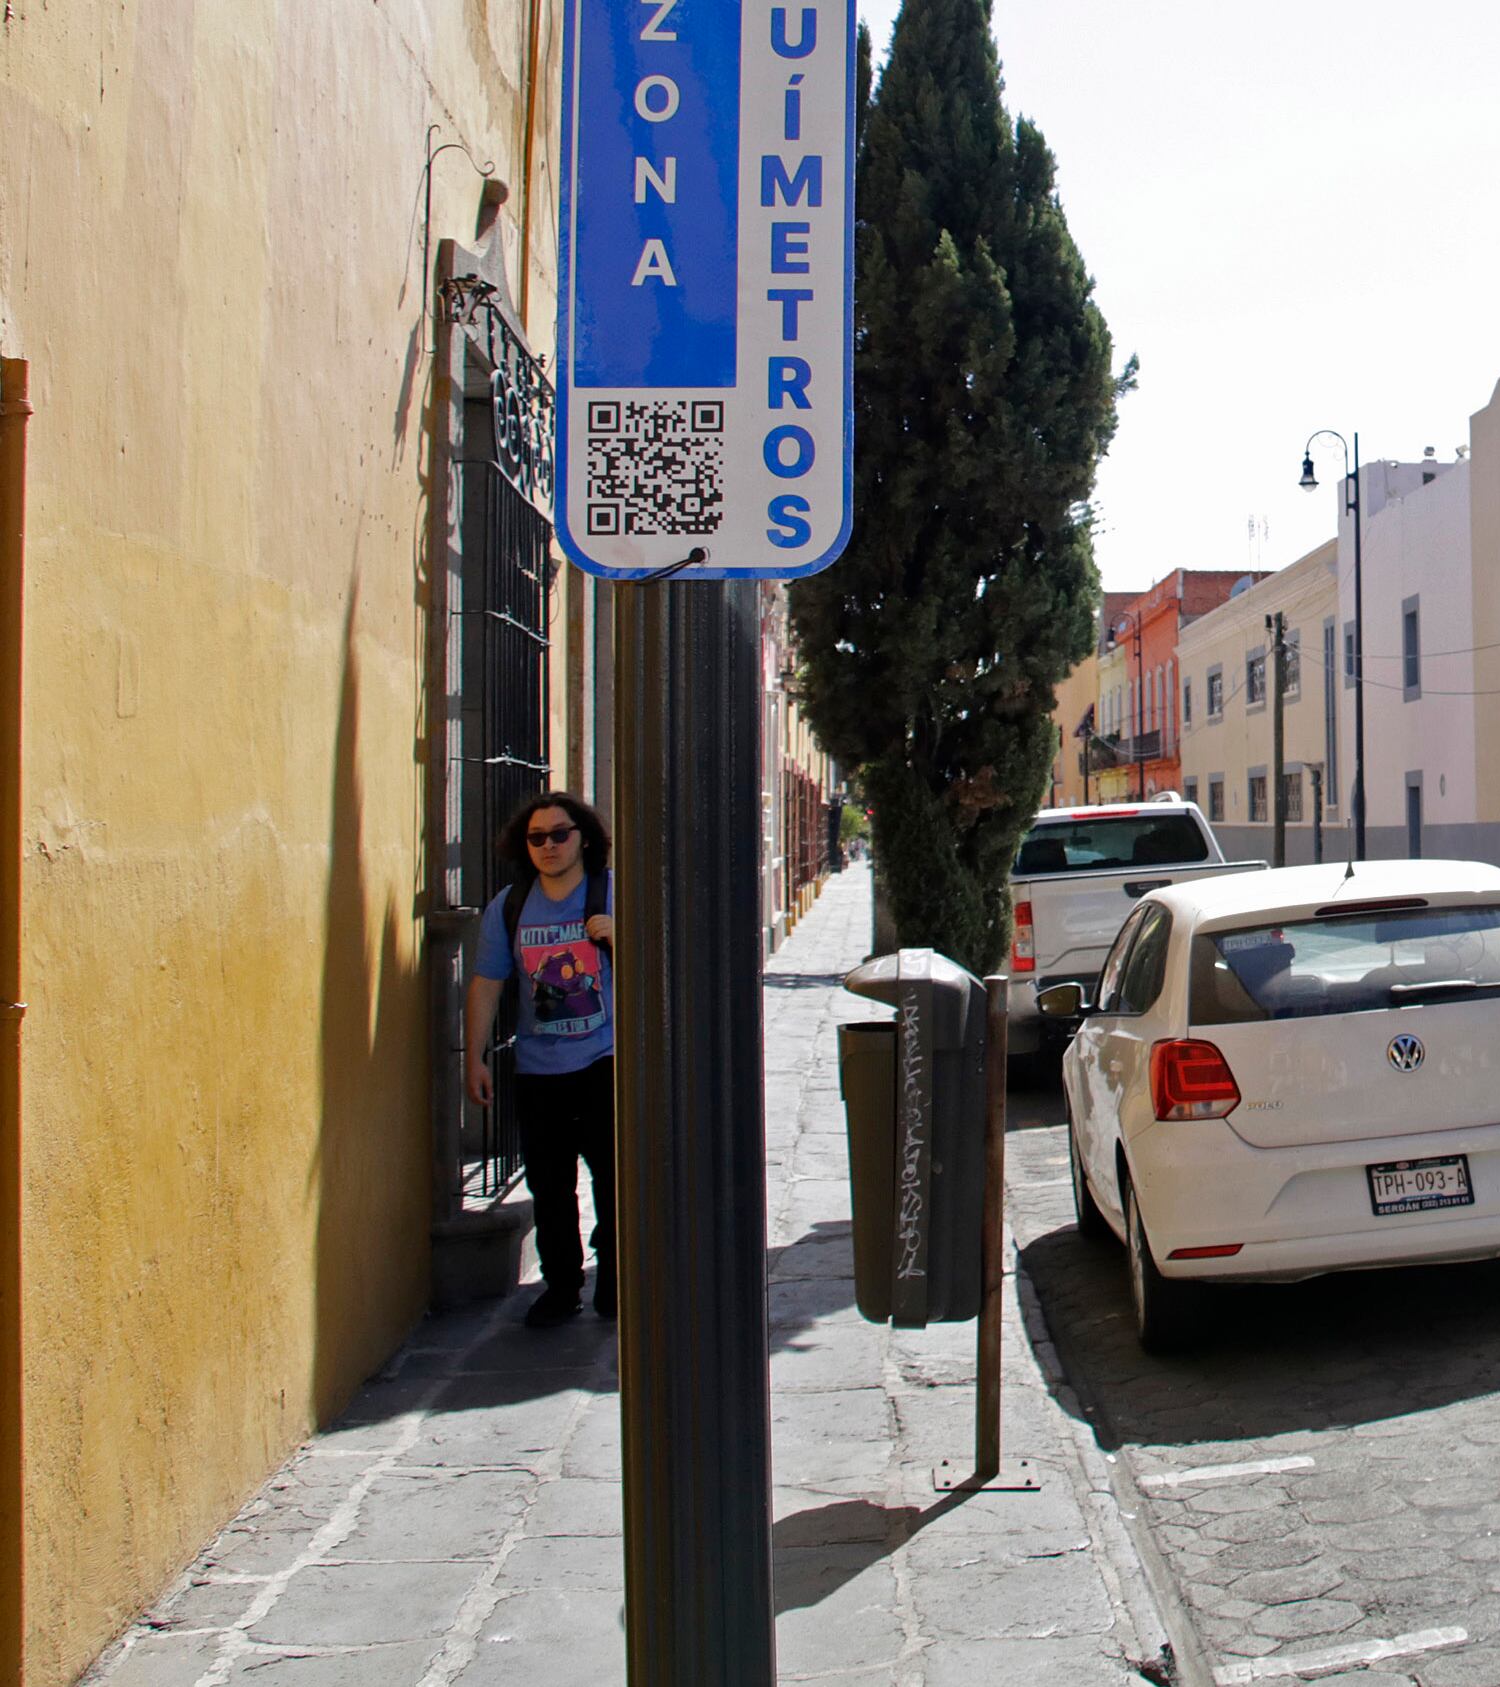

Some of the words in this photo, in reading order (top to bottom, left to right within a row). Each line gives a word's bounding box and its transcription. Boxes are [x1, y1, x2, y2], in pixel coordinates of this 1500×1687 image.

[631, 0, 679, 286] ZONA
[761, 7, 822, 548] UÍMETROS
[521, 926, 549, 945] KITTY
[1373, 1167, 1467, 1197] TPH-093-A
